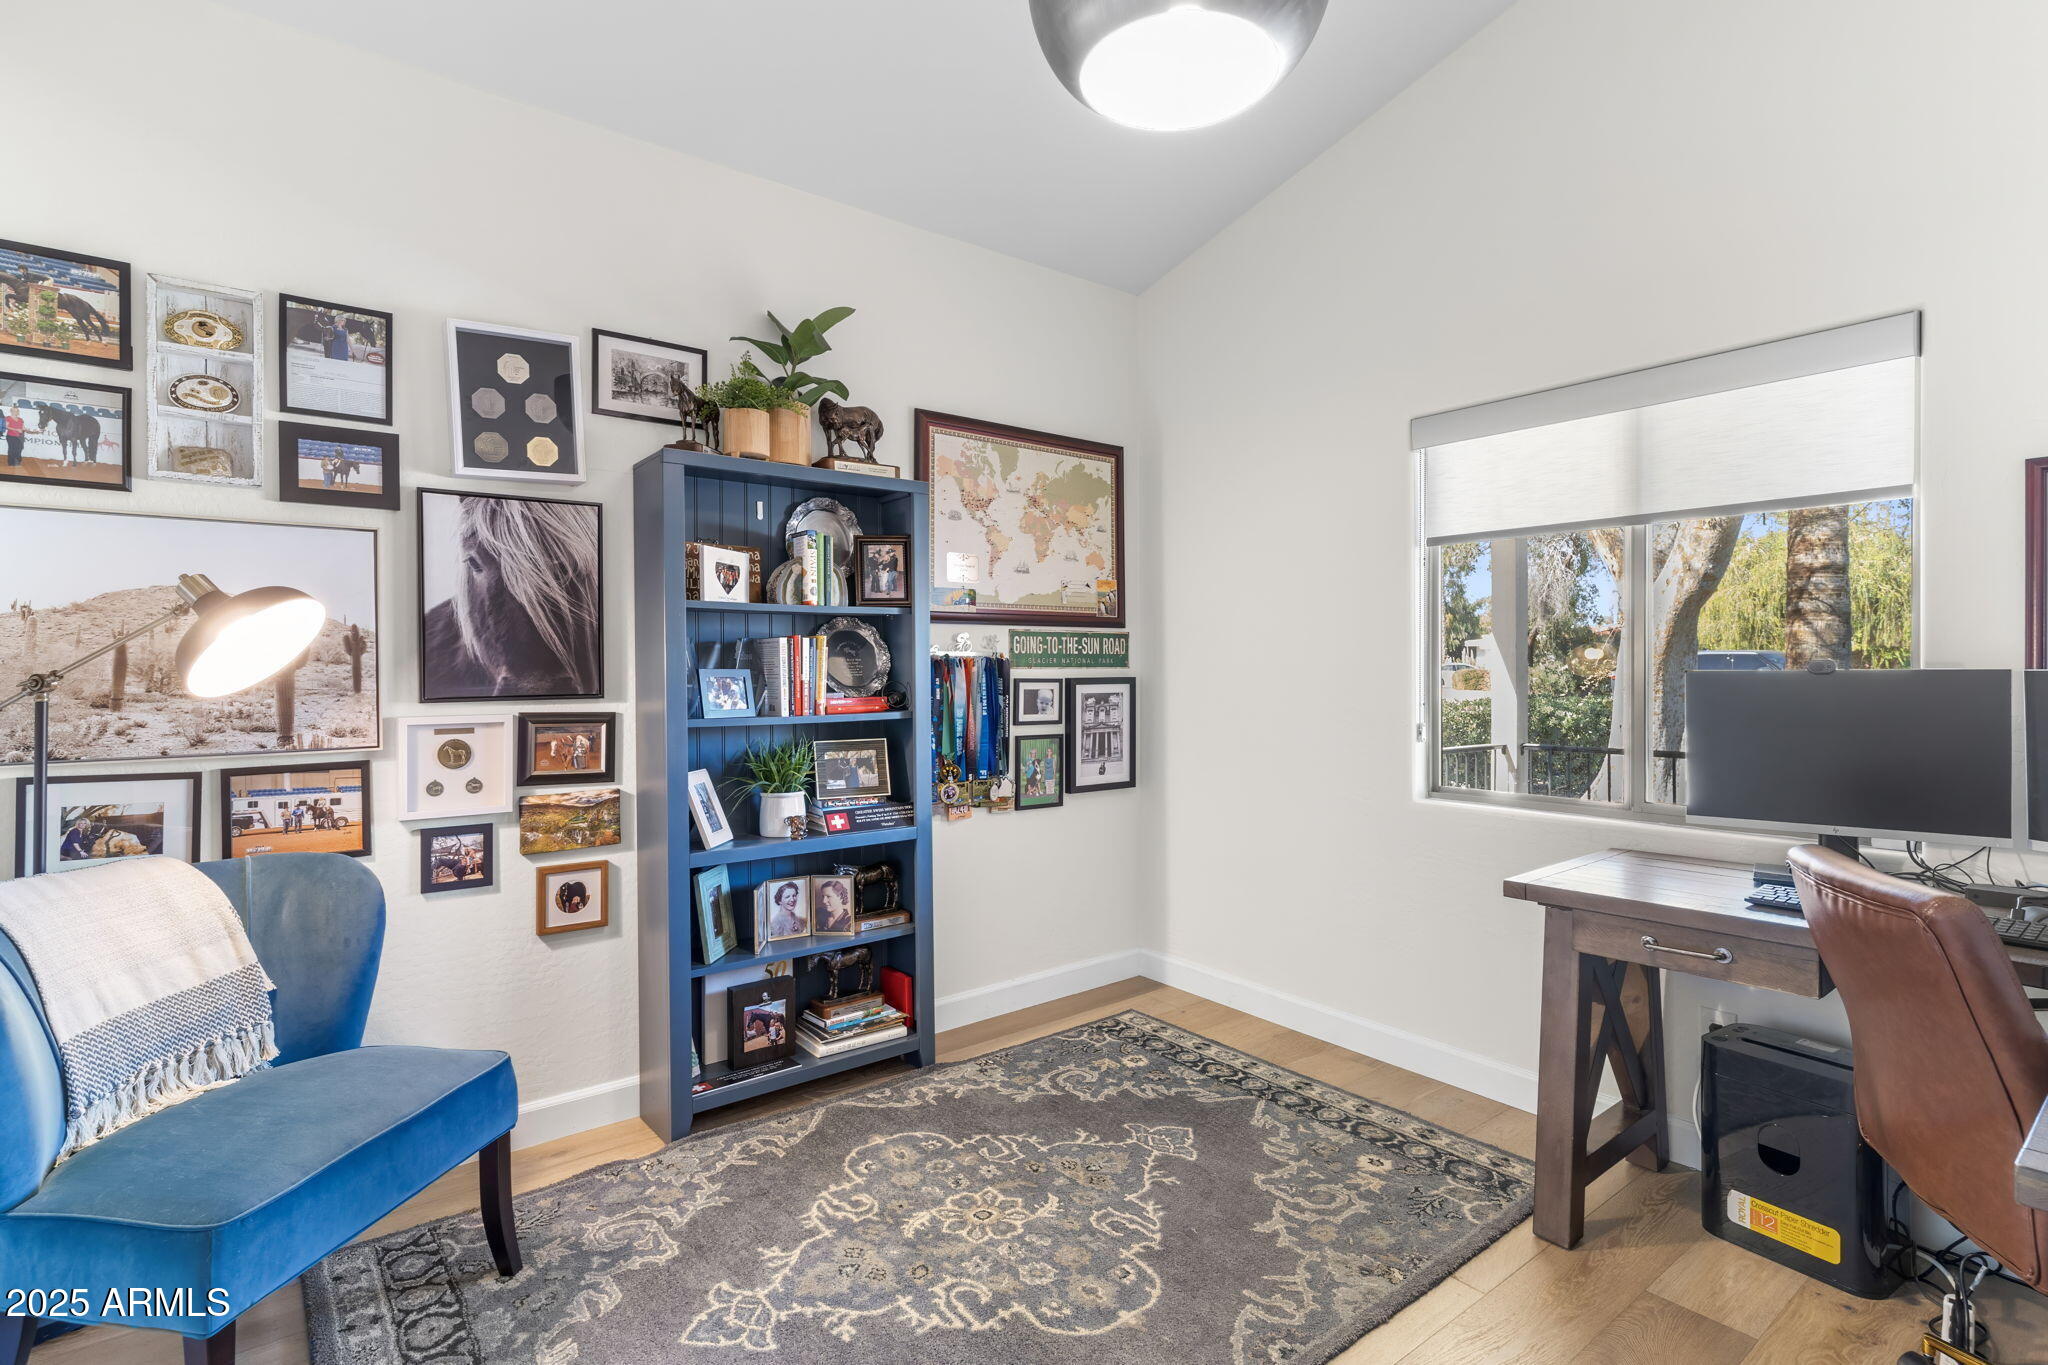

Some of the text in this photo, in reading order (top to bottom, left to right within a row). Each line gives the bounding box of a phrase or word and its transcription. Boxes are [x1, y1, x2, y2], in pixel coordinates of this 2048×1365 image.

[1013, 635, 1126, 655] GOING-TO-THE-SUN ROAD
[1061, 657, 1095, 665] NATIONAL
[1737, 1197, 1746, 1223] ROYAL
[1751, 1200, 1779, 1217] Crosscut
[1780, 1211, 1799, 1223] Paper
[1800, 1219, 1831, 1237] Shredder
[1760, 1212, 1774, 1228] 12
